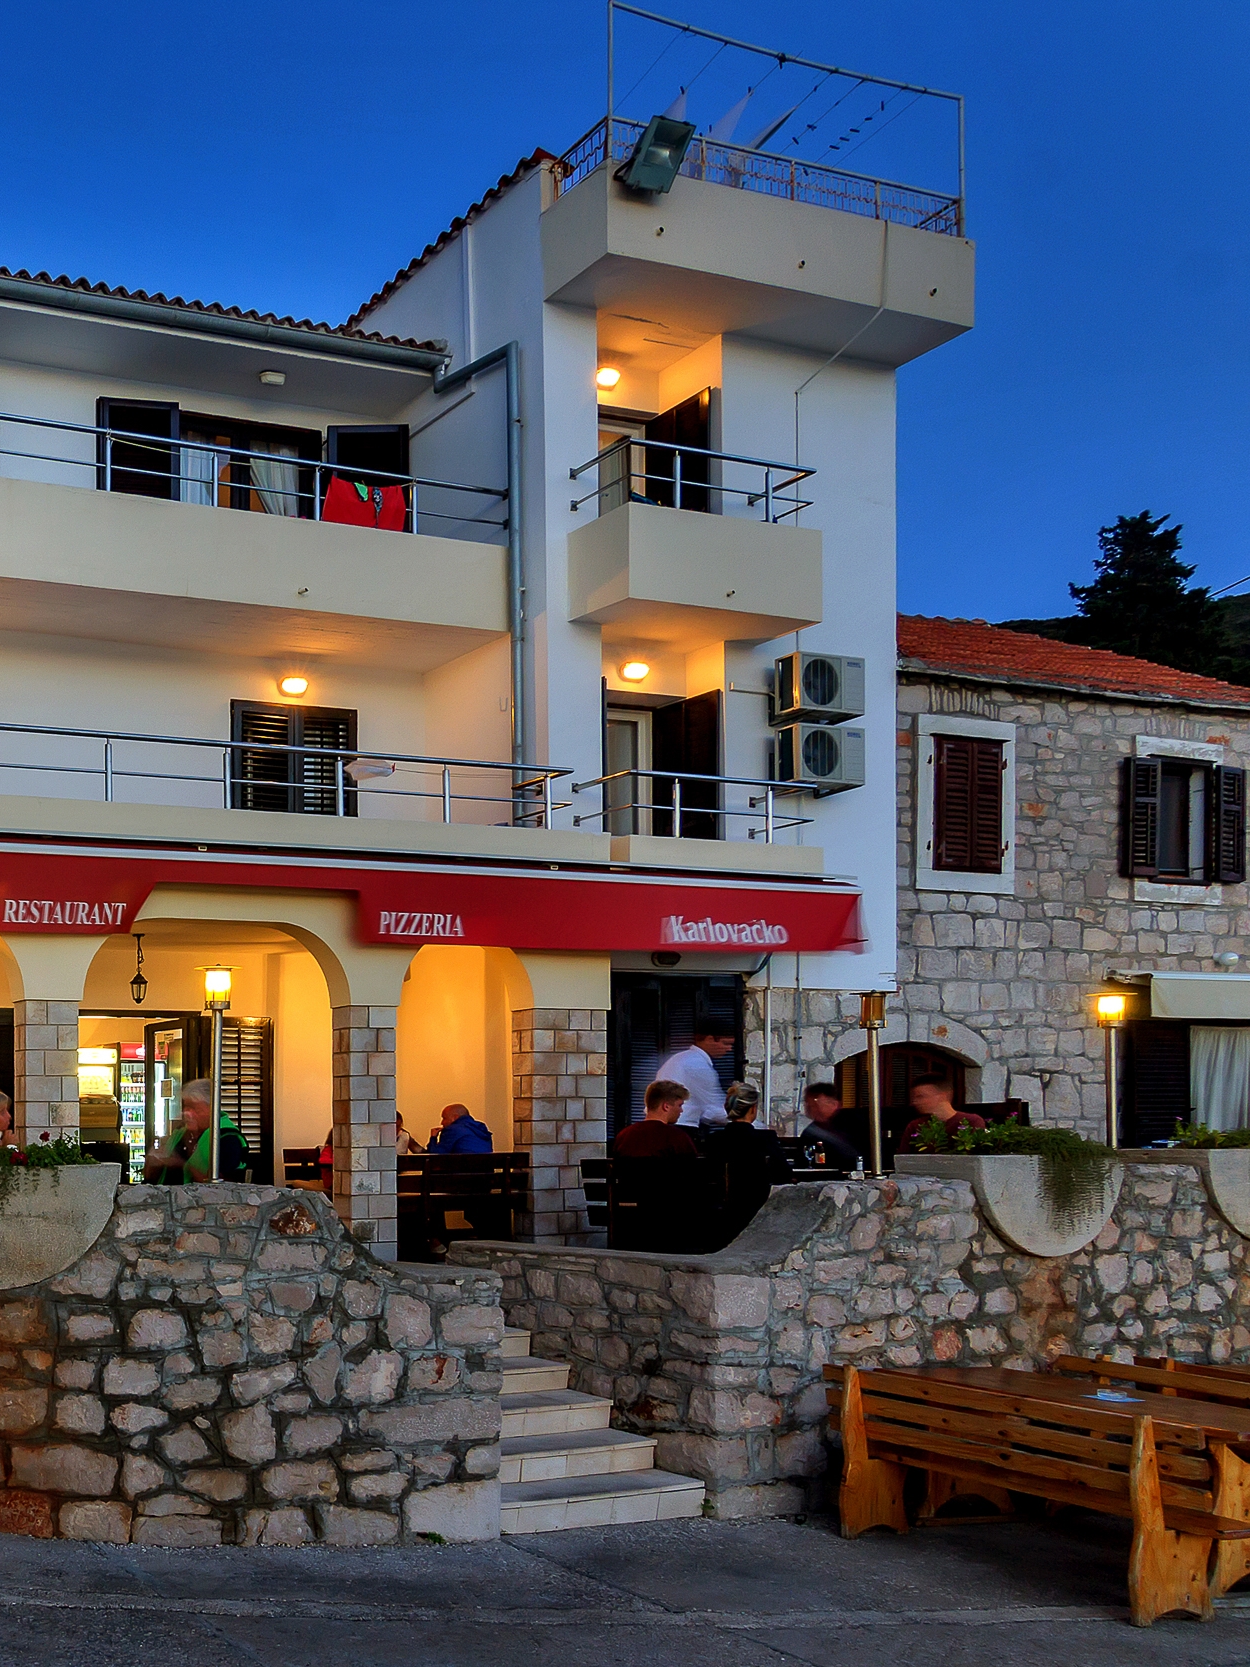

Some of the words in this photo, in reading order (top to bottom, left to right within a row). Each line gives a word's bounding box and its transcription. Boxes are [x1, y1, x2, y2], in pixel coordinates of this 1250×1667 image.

[2, 899, 127, 926] RESTAURANT
[378, 911, 465, 937] PIZZERIA
[662, 914, 790, 945] Karlovačko
